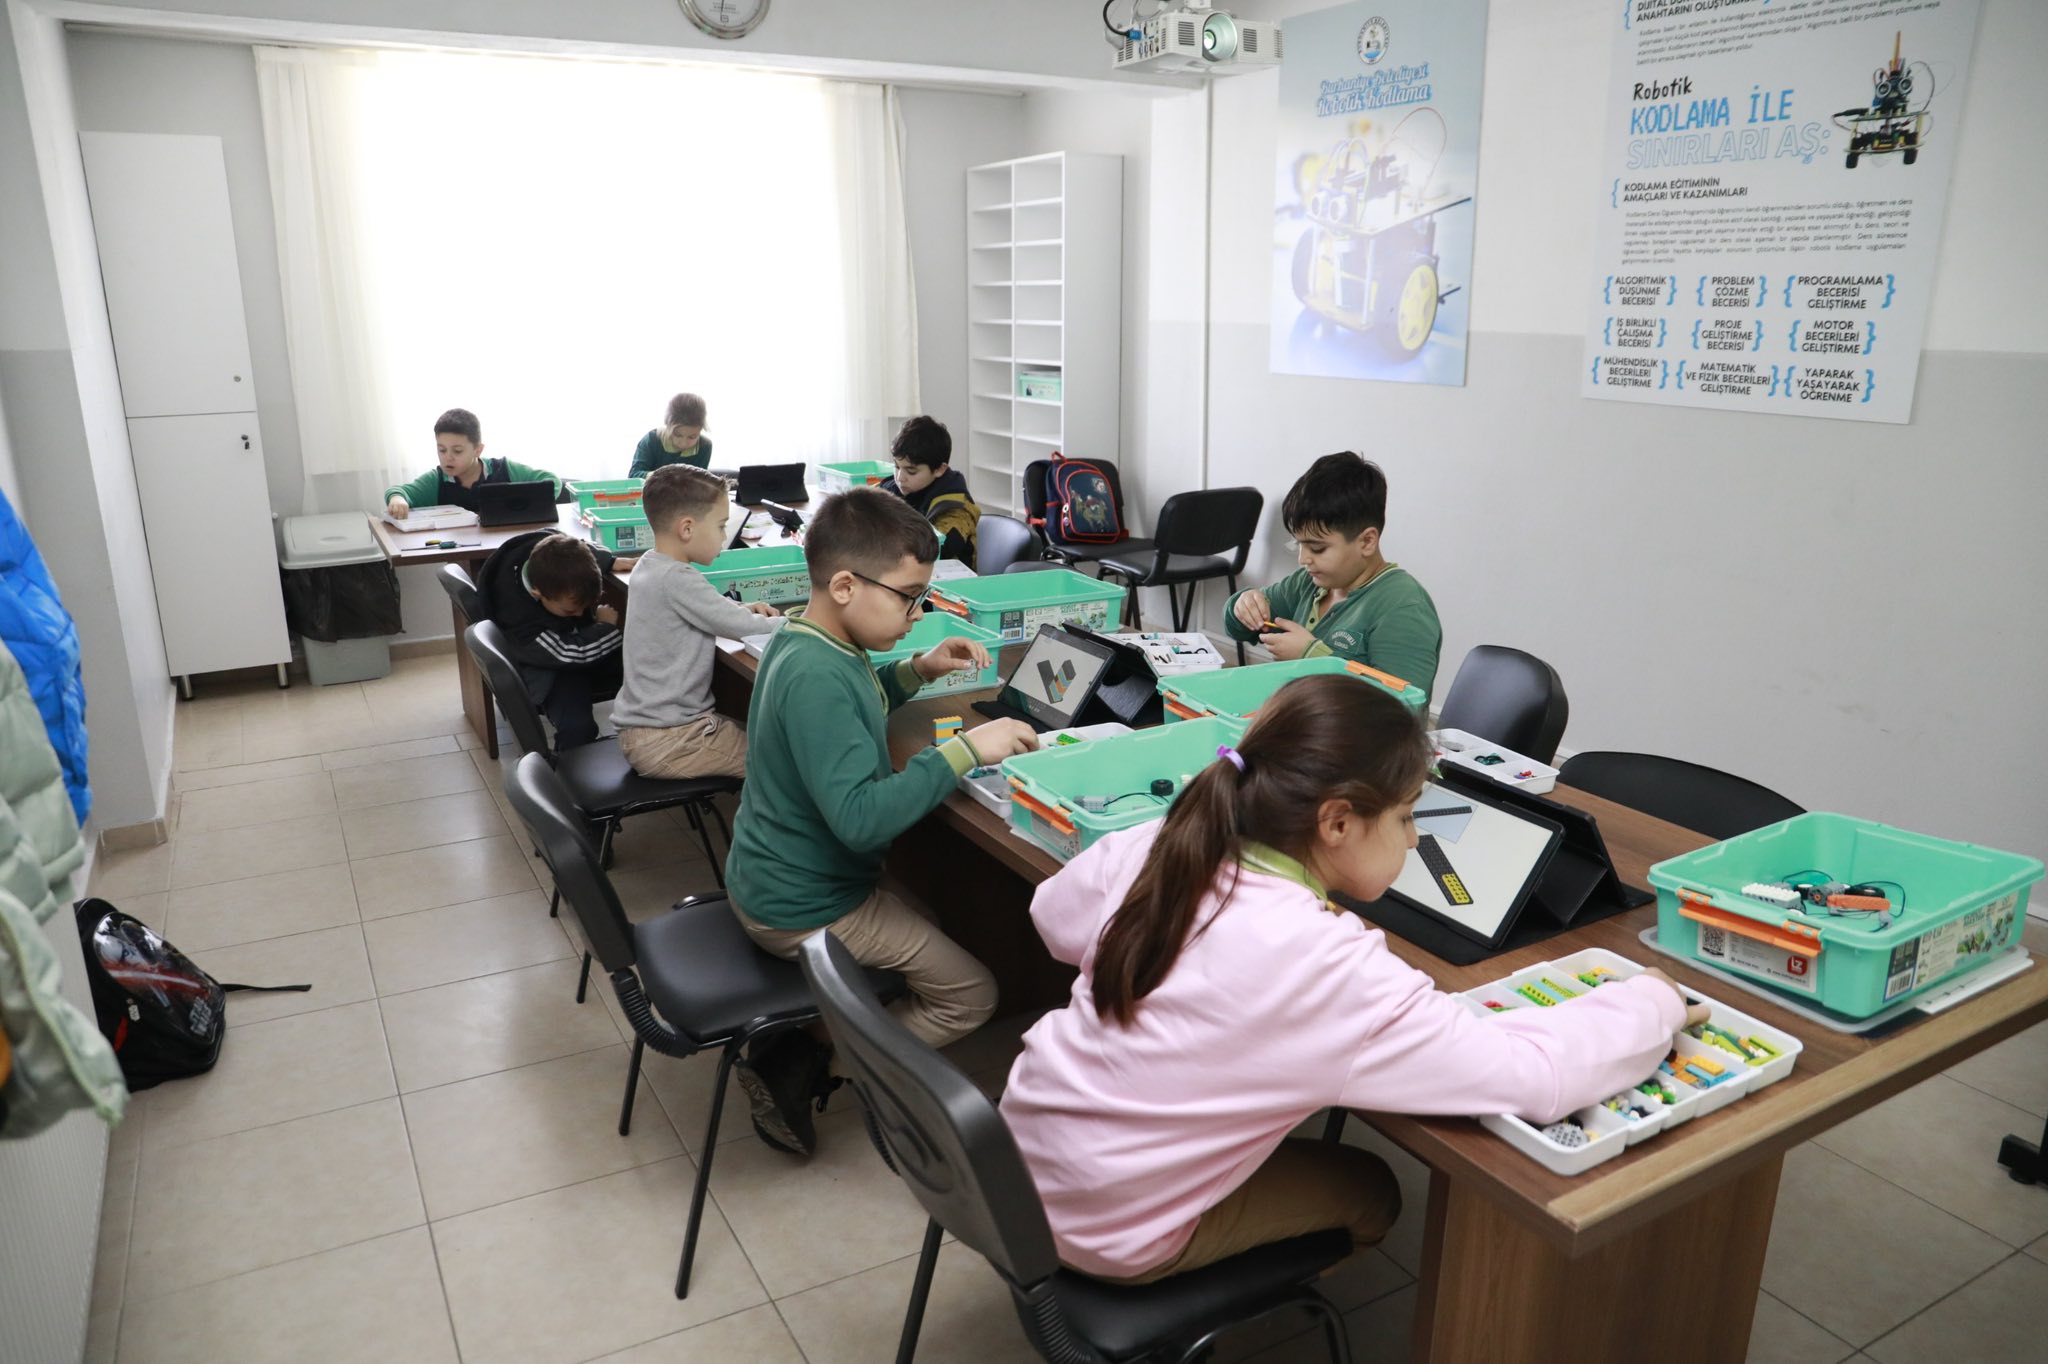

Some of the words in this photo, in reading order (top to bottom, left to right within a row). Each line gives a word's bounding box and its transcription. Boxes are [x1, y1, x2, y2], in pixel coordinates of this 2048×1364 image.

[1636, 3, 1693, 22] ANAHTARINI
[1633, 75, 1693, 101] Robotik
[1630, 97, 1730, 135] KODLAMA
[1747, 84, 1794, 123] İLE
[1626, 128, 1770, 170] SINIRLARI
[1774, 122, 1832, 165] AŞ:
[1624, 181, 1668, 192] KODLAMA
[1670, 177, 1721, 190] EĞİTİMİNİN
[1623, 190, 1667, 203] AMAÇLARI
[1670, 189, 1682, 199] VE
[1683, 186, 1748, 199] KAZANIMLARI
[1615, 274, 1667, 285] ALGORİTMİK
[1712, 276, 1755, 286] PROBLEM
[1799, 275, 1884, 286] PROGRAMLAMA
[1619, 285, 1661, 296] DÜŞÜNME
[1715, 286, 1749, 297] ÇÖZME
[1817, 286, 1860, 298] BECERİSİ
[1621, 296, 1656, 306] BECERİSİ
[1712, 297, 1750, 307] BECERİSİ
[1808, 298, 1867, 311] GELİŞTİRME
[1617, 317, 1623, 328] İŞ
[1625, 317, 1657, 328] BİRLİKLİ
[1715, 319, 1742, 329] PROJE
[1813, 320, 1854, 331] MOTOR
[1617, 328, 1653, 339] ÇALIŞMA
[1701, 329, 1753, 341] GELİŞTİRME
[1805, 330, 1860, 342] BECERİLERİ
[1618, 338, 1651, 348] BECERİSİ
[1707, 340, 1745, 351] BECERİSİ
[1802, 342, 1860, 355] GELİŞTİRME
[1604, 356, 1658, 368] MÜHENDİSLİK
[1701, 361, 1757, 373] MATEMATİK
[1609, 367, 1652, 378] BECERİLERİ
[1685, 371, 1696, 381] VE
[1698, 371, 1720, 382] FİZİK
[1722, 374, 1771, 386] BECERİLERİ
[1805, 367, 1855, 380] YAPARAK
[1607, 376, 1653, 388] GELİŞTİRME
[1797, 379, 1860, 392] YAŞAYARAK
[1701, 383, 1752, 395] GELİŞTİRME
[1801, 389, 1852, 403] ÖĞRENME
